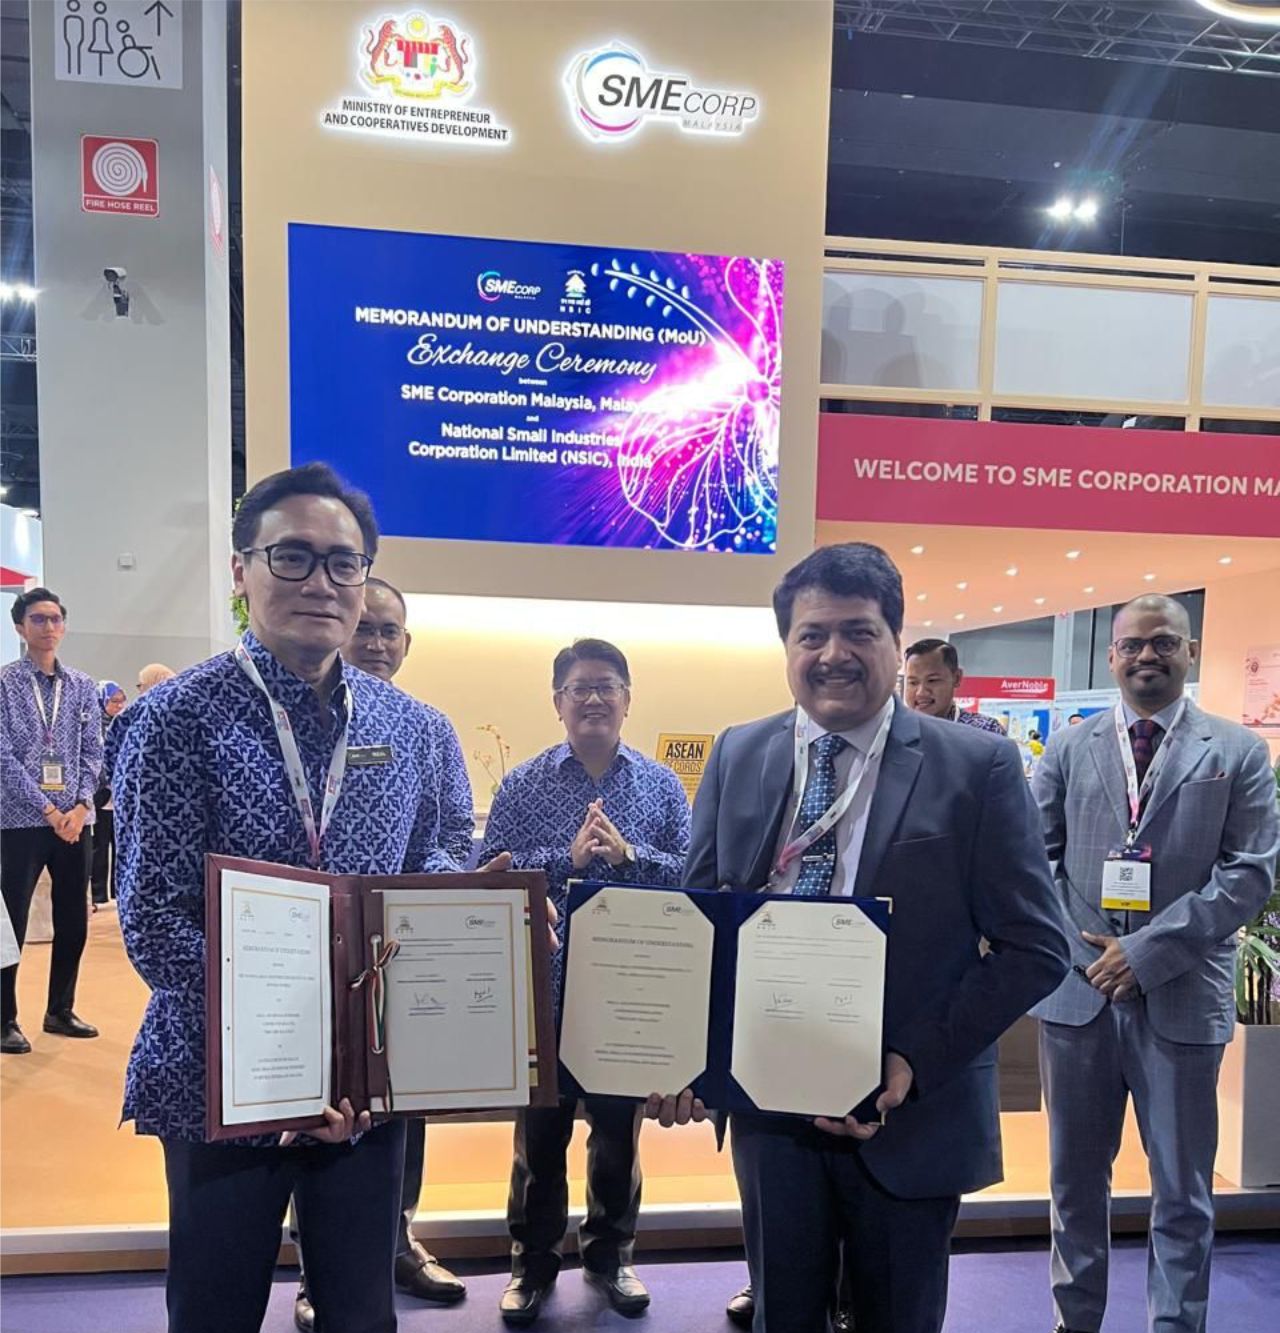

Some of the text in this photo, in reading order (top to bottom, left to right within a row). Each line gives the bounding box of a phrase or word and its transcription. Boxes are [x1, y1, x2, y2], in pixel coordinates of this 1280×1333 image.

[342, 100, 490, 124] MINISTRY OF ENTREPRENEUR
[325, 113, 508, 140] AND COOPERATIVES DEVELOPMENT
[86, 199, 155, 212] FIRE HOSE REEL
[355, 307, 706, 346] MEMORANDUM OF UNDERSTANDING (MoU)
[407, 333, 658, 383] Exchange Ceremony
[518, 377, 548, 386] between
[401, 384, 434, 400] SME
[437, 387, 527, 405] Corporation
[531, 392, 596, 412] Malaysia,
[441, 422, 621, 447] National Small Industries
[408, 441, 498, 461] Corporation
[502, 447, 557, 464] Limited
[561, 451, 613, 468] (NSIC),
[853, 457, 979, 484] WELCOME
[984, 464, 1016, 486] TO
[1022, 466, 1072, 489] SME
[1078, 470, 1248, 496] CORPORATION
[665, 743, 705, 759] ASEAN
